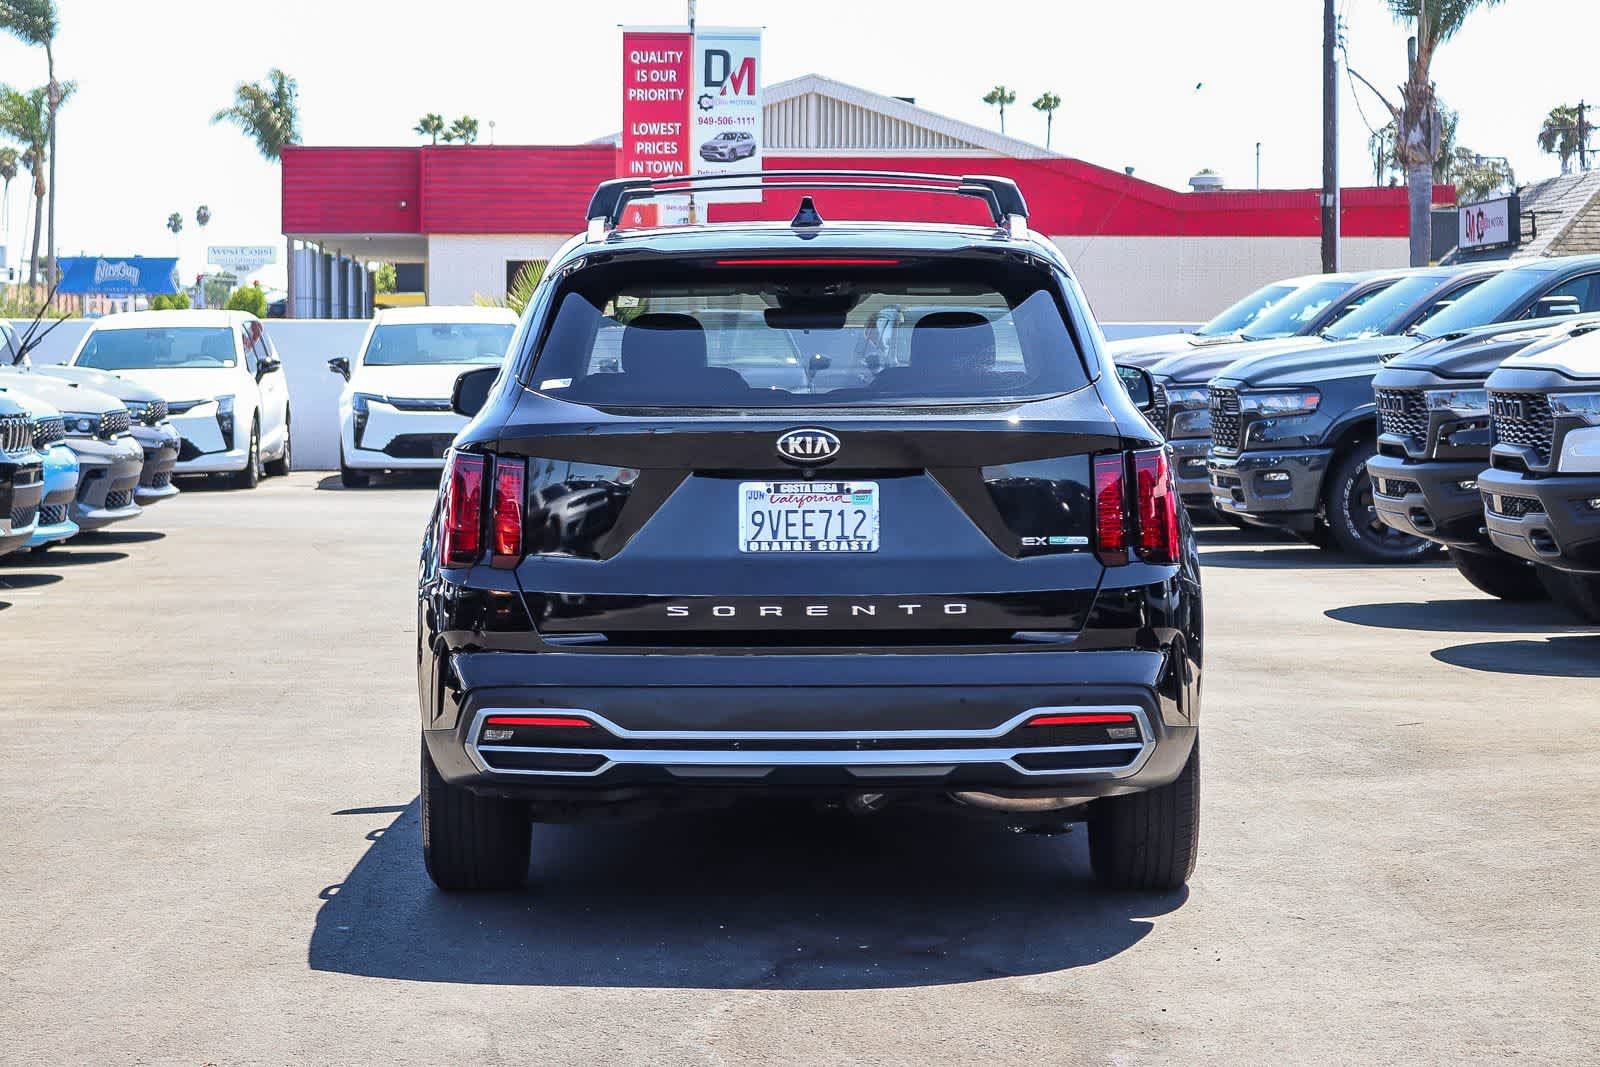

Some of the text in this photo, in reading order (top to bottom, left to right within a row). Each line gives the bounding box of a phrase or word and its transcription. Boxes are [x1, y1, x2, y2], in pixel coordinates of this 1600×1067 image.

[630, 50, 683, 65] QUALITY
[636, 69, 677, 82] IS OUR
[628, 88, 684, 101] PRIORITY
[697, 116, 755, 126] 949-506-1111
[632, 122, 682, 136] LOWEST
[636, 141, 679, 155] PRICES
[631, 161, 645, 174] IN
[647, 161, 684, 174] TOWN
[787, 436, 831, 454] KIA
[780, 483, 838, 493] COSTA MESA
[748, 490, 765, 501] JUN
[769, 494, 844, 508] California
[751, 509, 867, 540] 9VEE712
[749, 541, 871, 551] ORANGE COAST
[1021, 536, 1048, 546] EX
[666, 603, 968, 617] SORENTO
